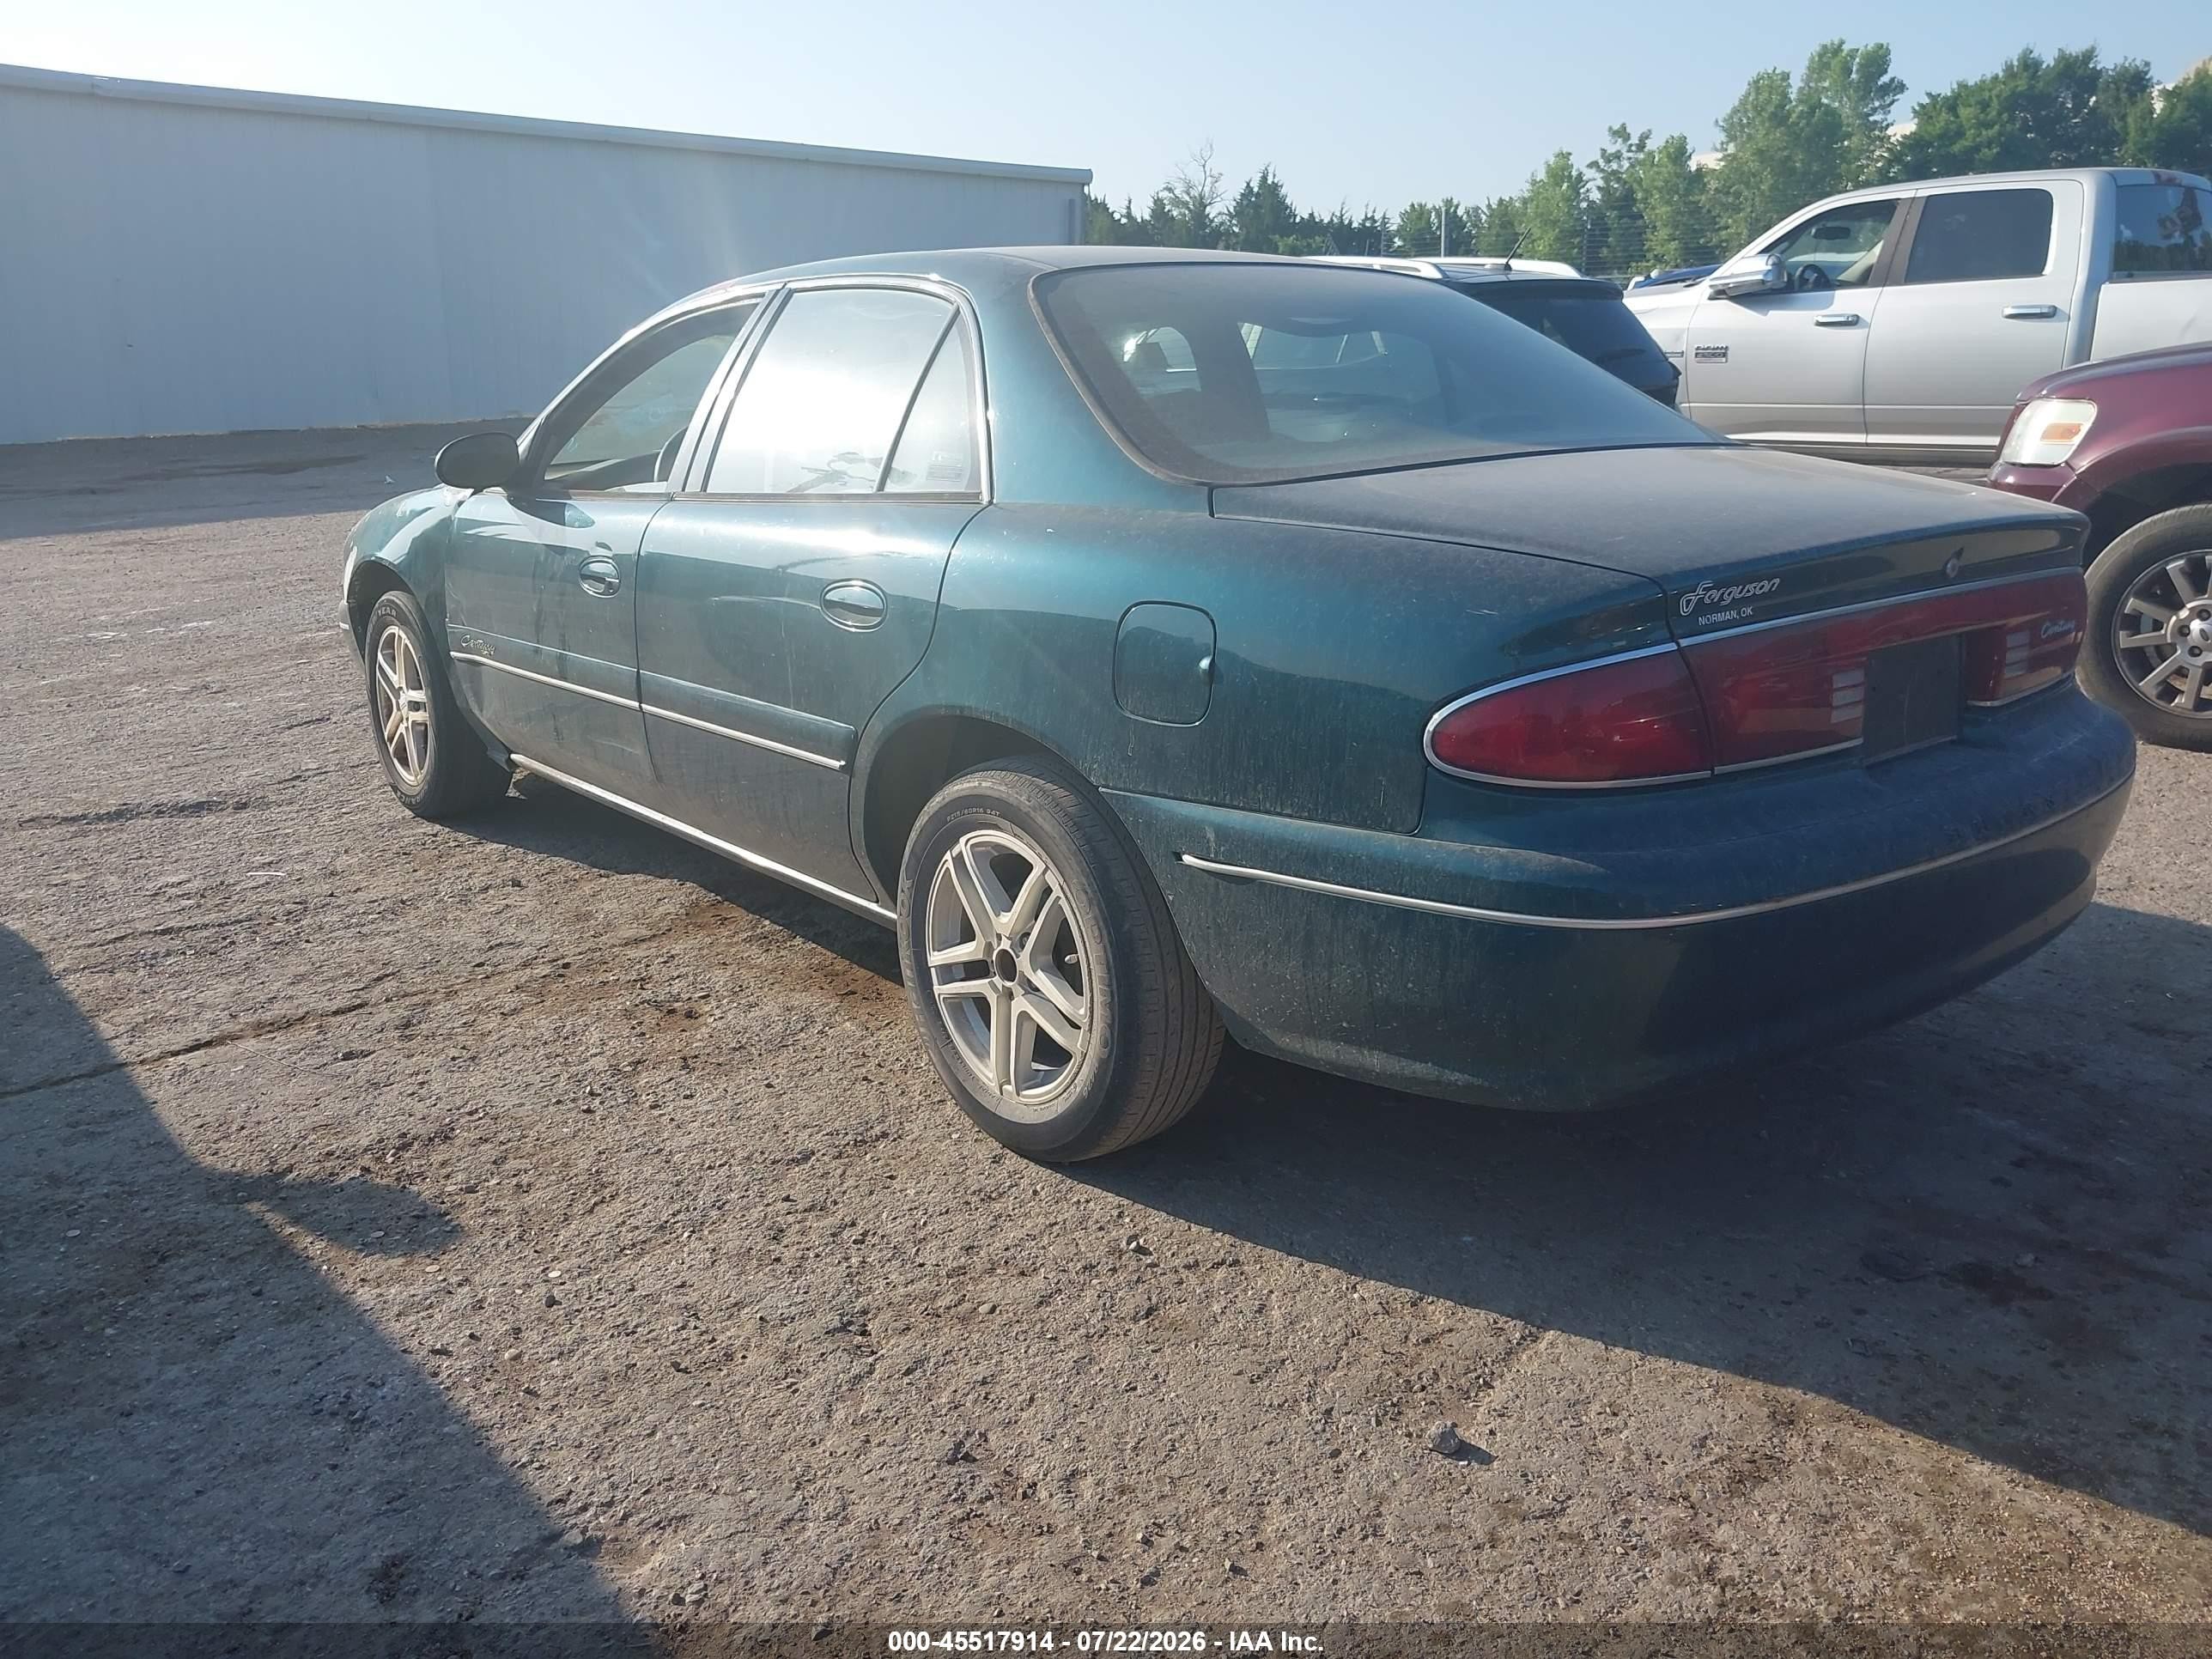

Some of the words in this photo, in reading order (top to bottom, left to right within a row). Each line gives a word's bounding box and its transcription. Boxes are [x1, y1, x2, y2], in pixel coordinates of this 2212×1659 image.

[1680, 580, 1780, 616] Ferguson
[1698, 611, 1740, 626] NORMAN,
[1741, 606, 1753, 617] OK
